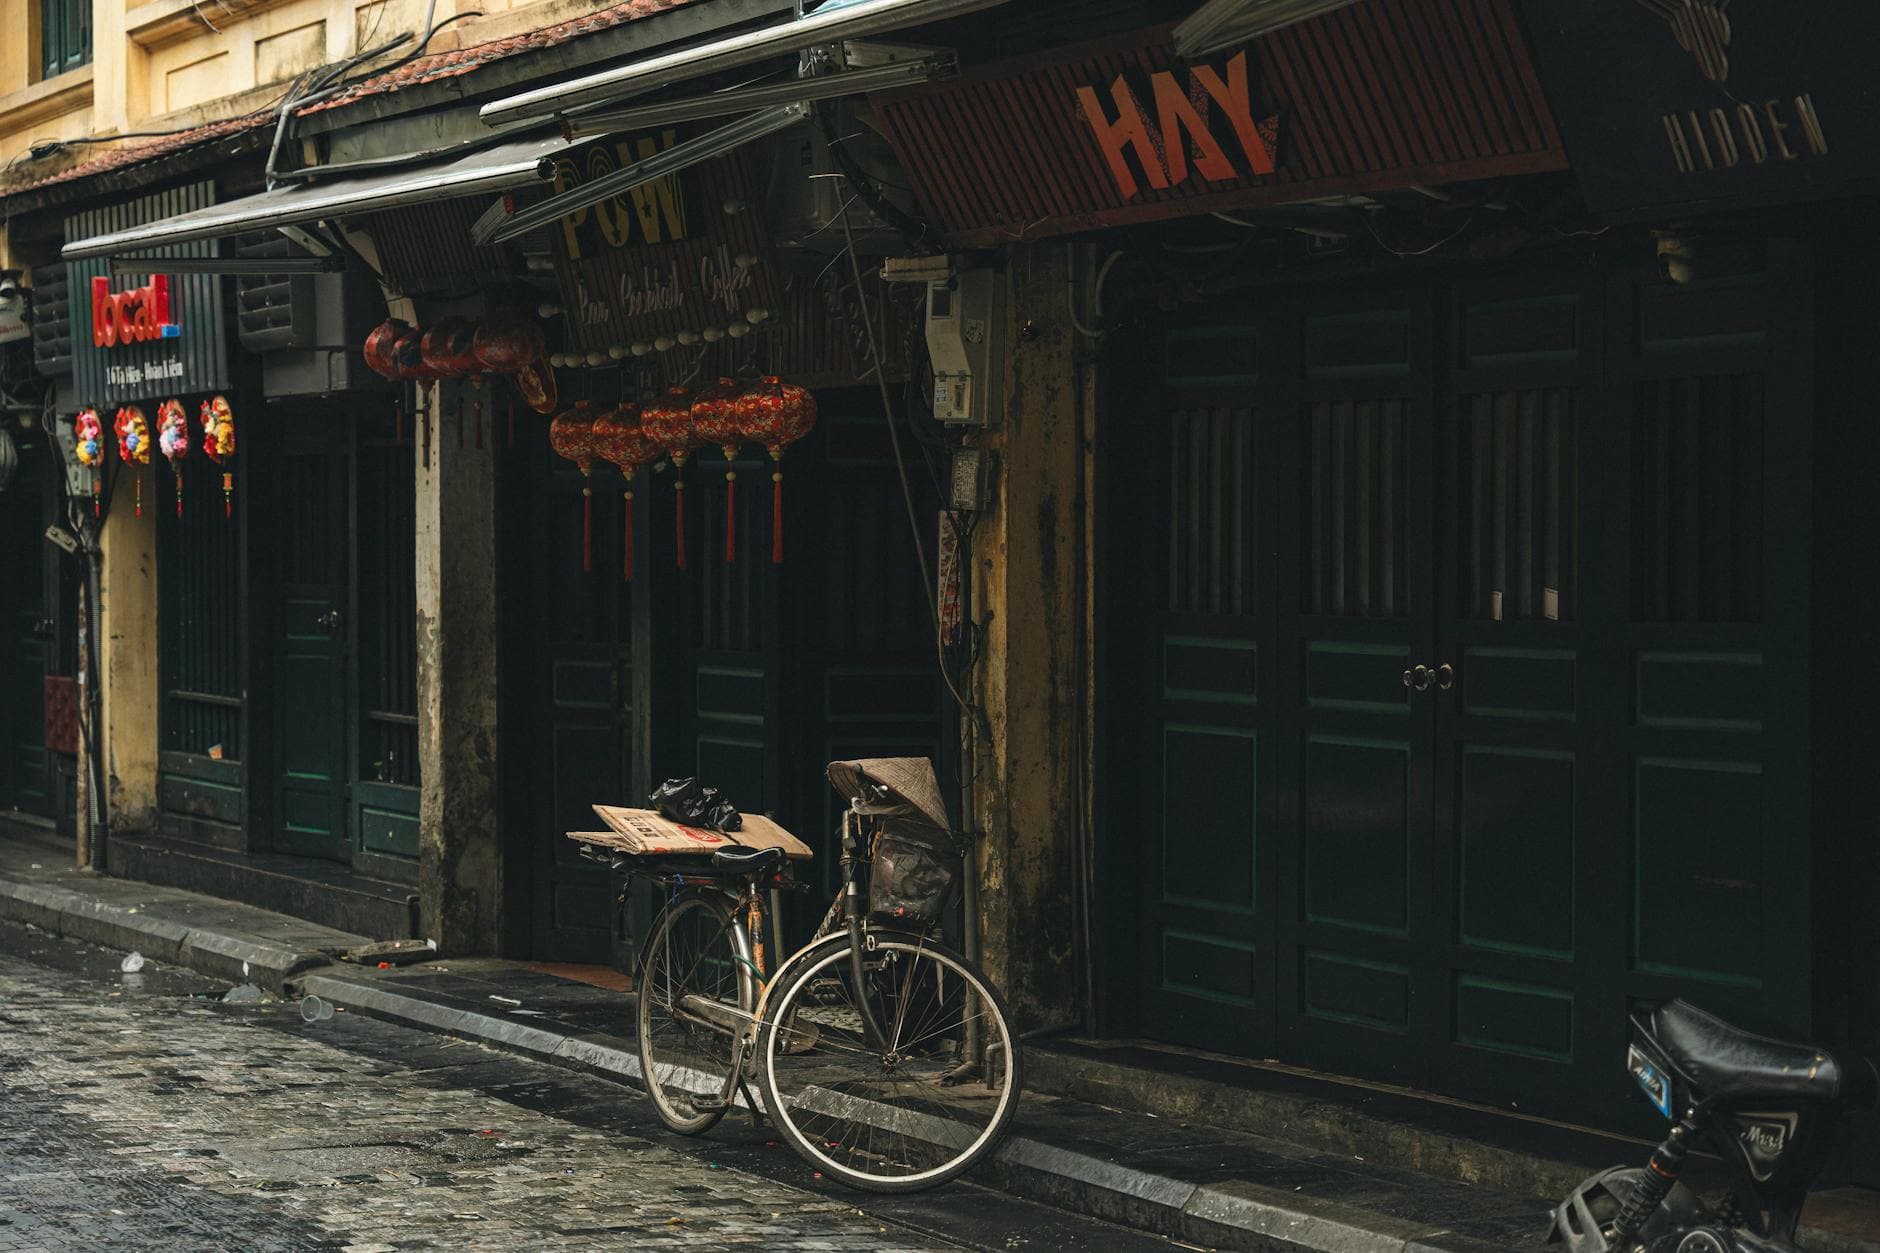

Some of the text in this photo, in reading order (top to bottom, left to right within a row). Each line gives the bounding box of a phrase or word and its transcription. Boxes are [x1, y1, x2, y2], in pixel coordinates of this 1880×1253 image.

[1075, 50, 1276, 200] HAY
[1663, 93, 1829, 173] HIDDEN
[553, 129, 688, 260] POW
